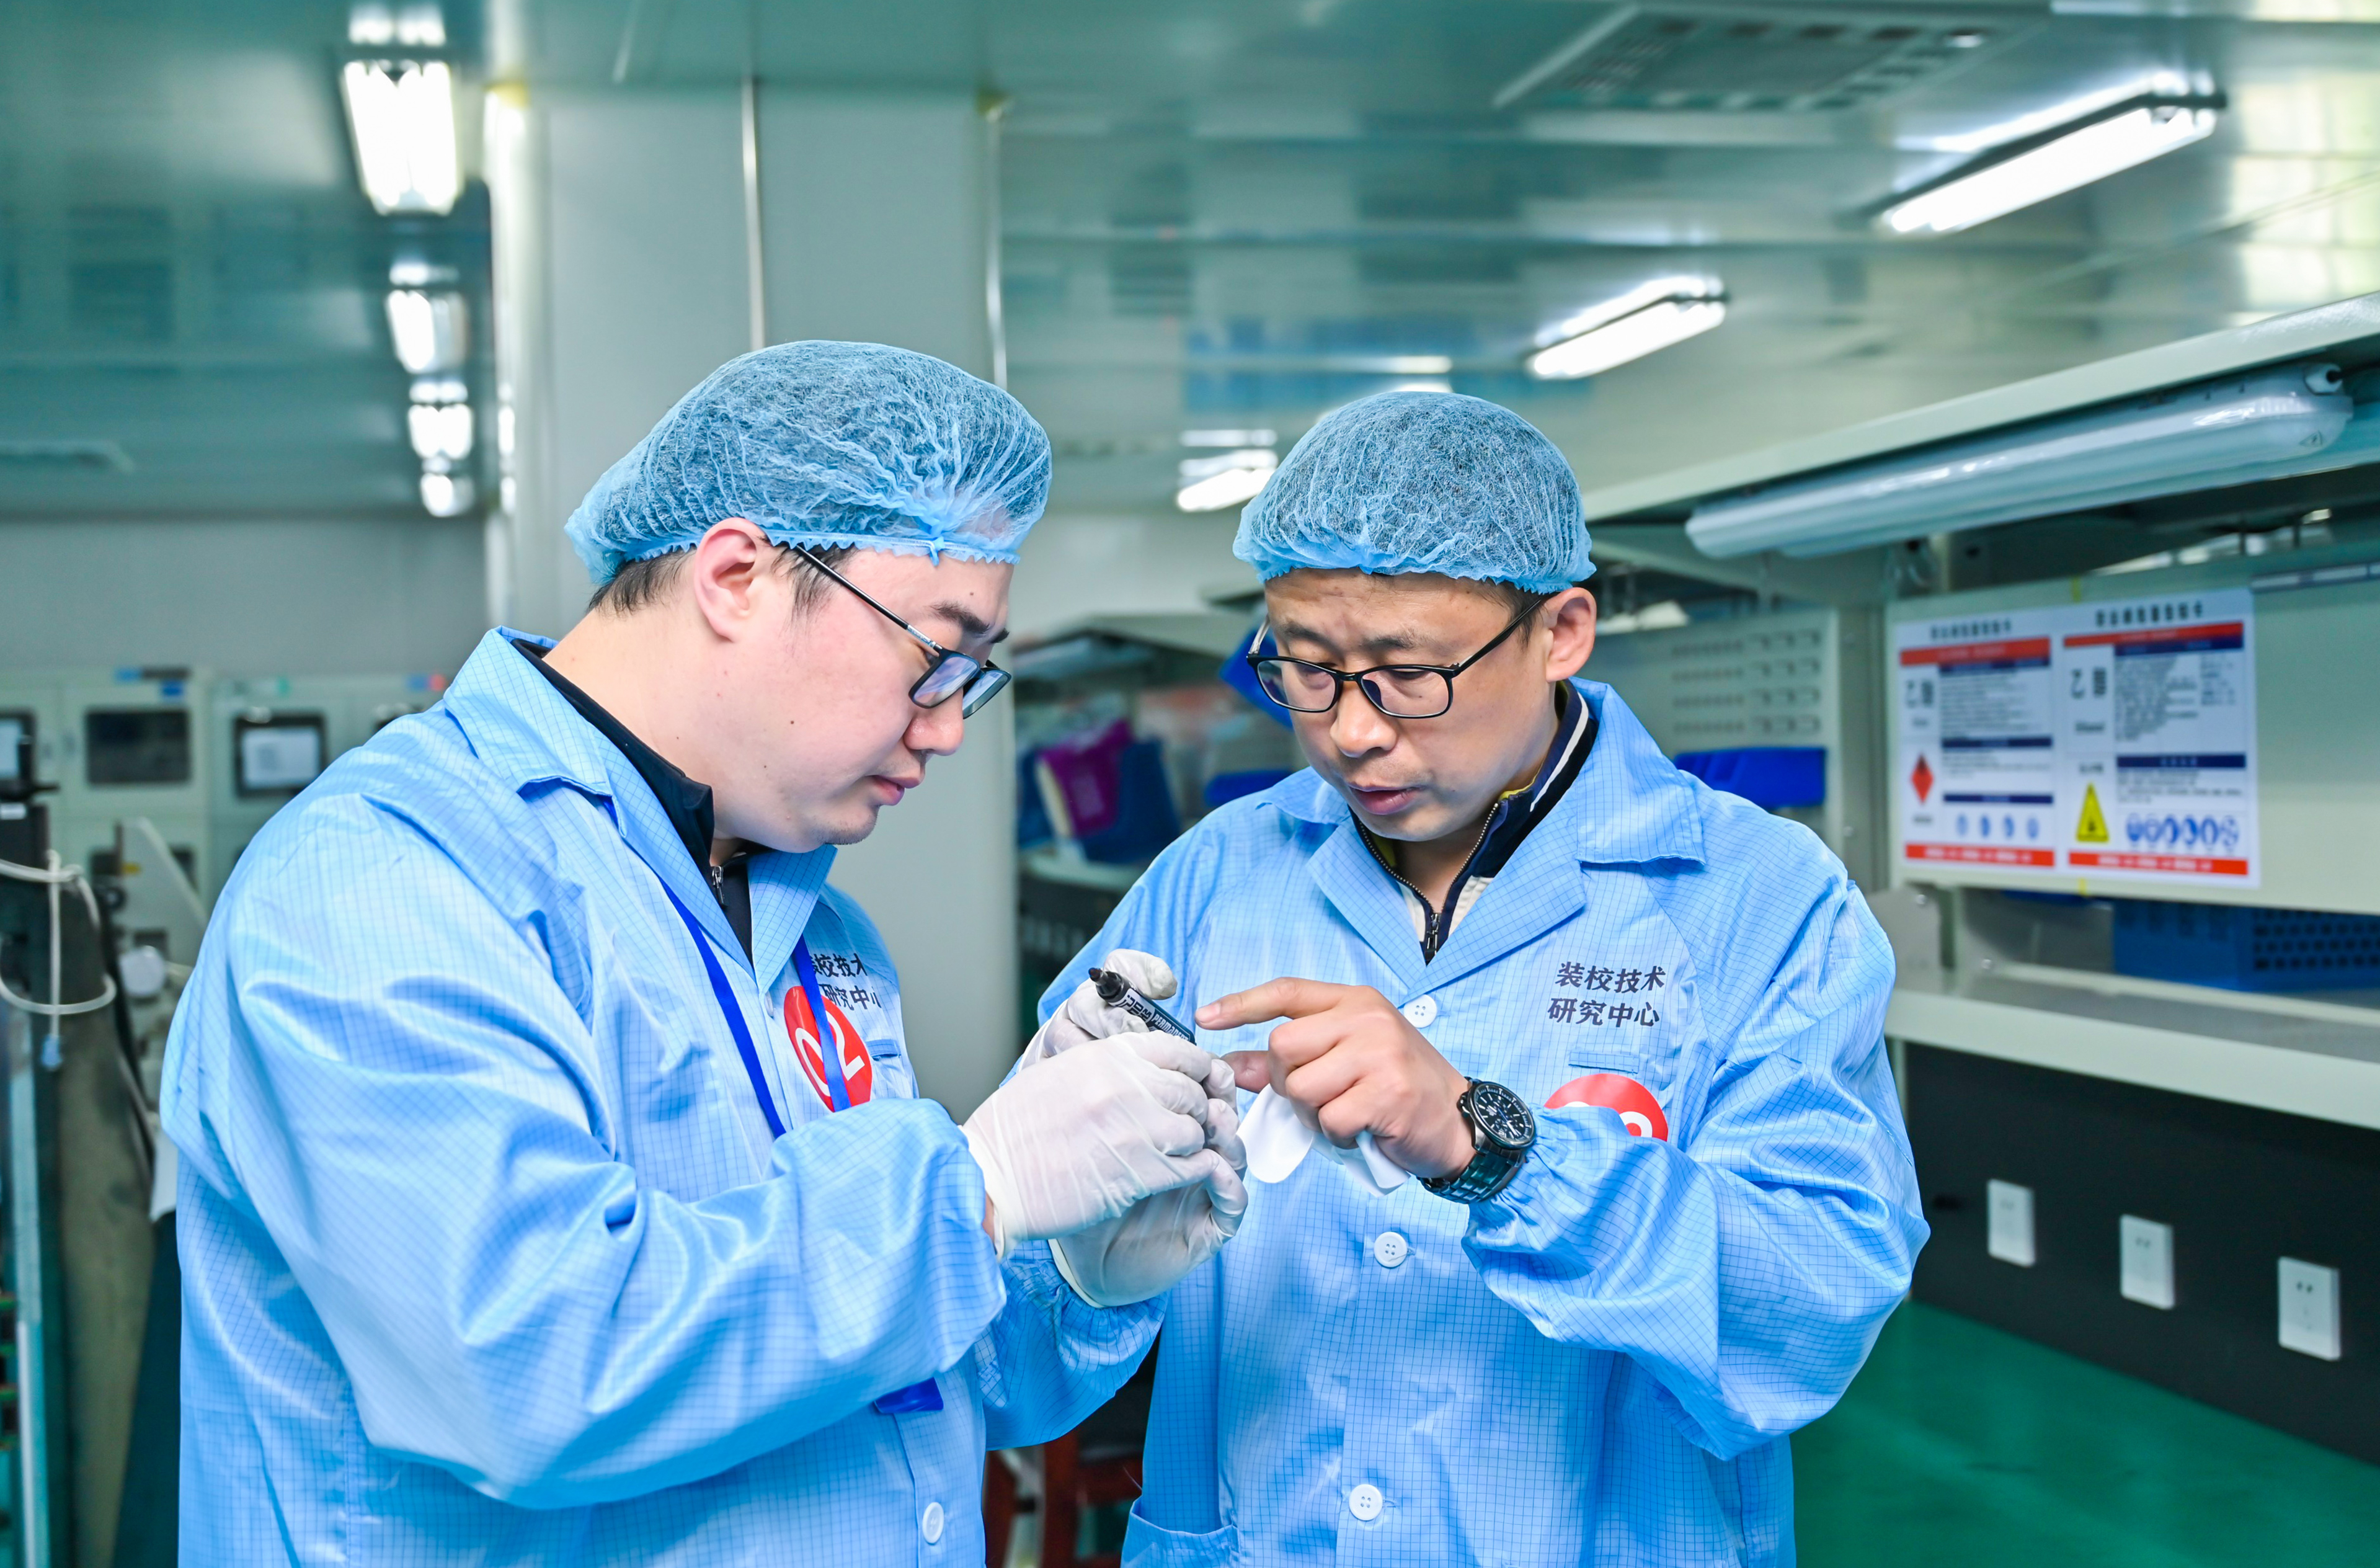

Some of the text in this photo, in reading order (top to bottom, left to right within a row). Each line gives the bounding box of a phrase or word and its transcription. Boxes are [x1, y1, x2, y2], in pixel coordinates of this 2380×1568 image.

[1555, 961, 1666, 994] 装校技术
[1547, 997, 1659, 1028] 研究中心
